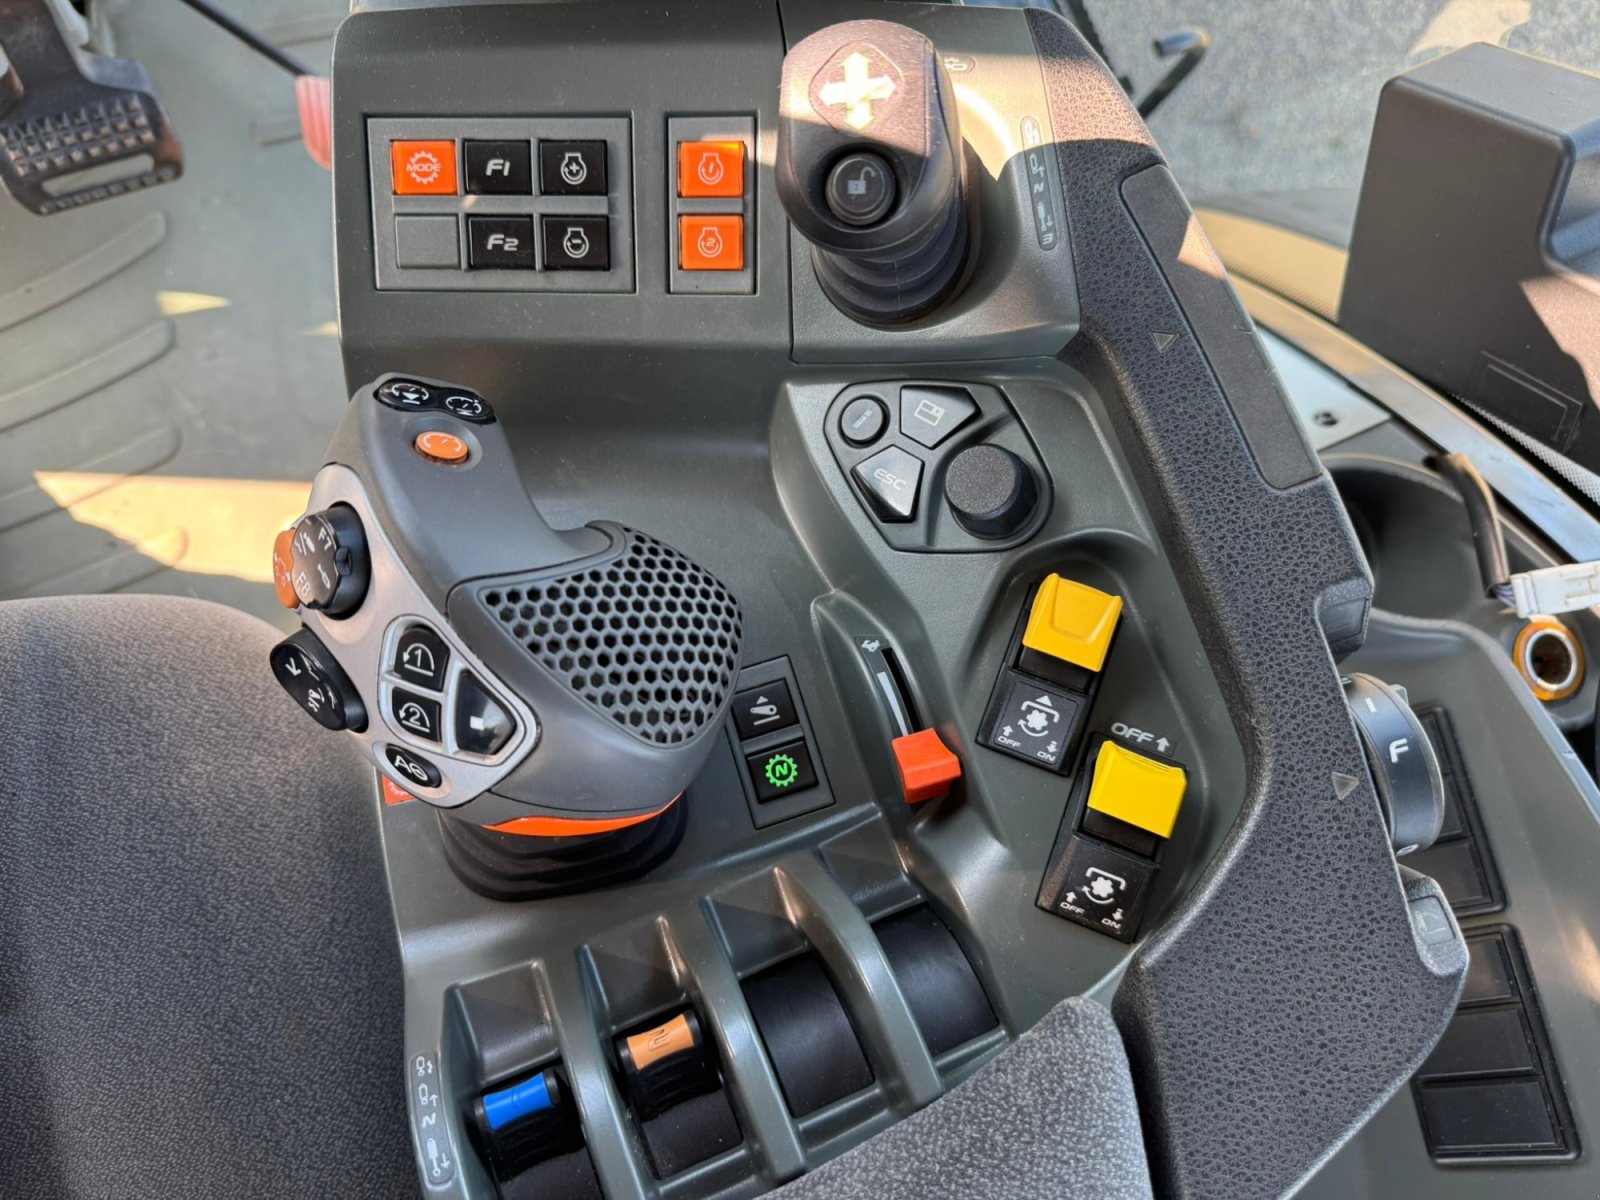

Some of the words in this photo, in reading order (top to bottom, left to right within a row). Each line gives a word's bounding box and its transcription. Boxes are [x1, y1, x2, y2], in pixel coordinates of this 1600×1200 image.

[406, 163, 441, 172] MODE
[486, 234, 519, 251] F2
[873, 468, 906, 490] ESC
[318, 526, 333, 551] F7
[295, 571, 311, 595] F8
[415, 649, 422, 668] 1
[409, 707, 421, 725] 2
[1110, 722, 1156, 743] OFF
[997, 735, 1022, 748] OFF
[1036, 750, 1057, 762] ON
[1389, 738, 1409, 764] F
[774, 763, 789, 778] N
[1059, 901, 1086, 915] OFF
[1101, 918, 1122, 930] ON
[421, 1112, 437, 1129] N
